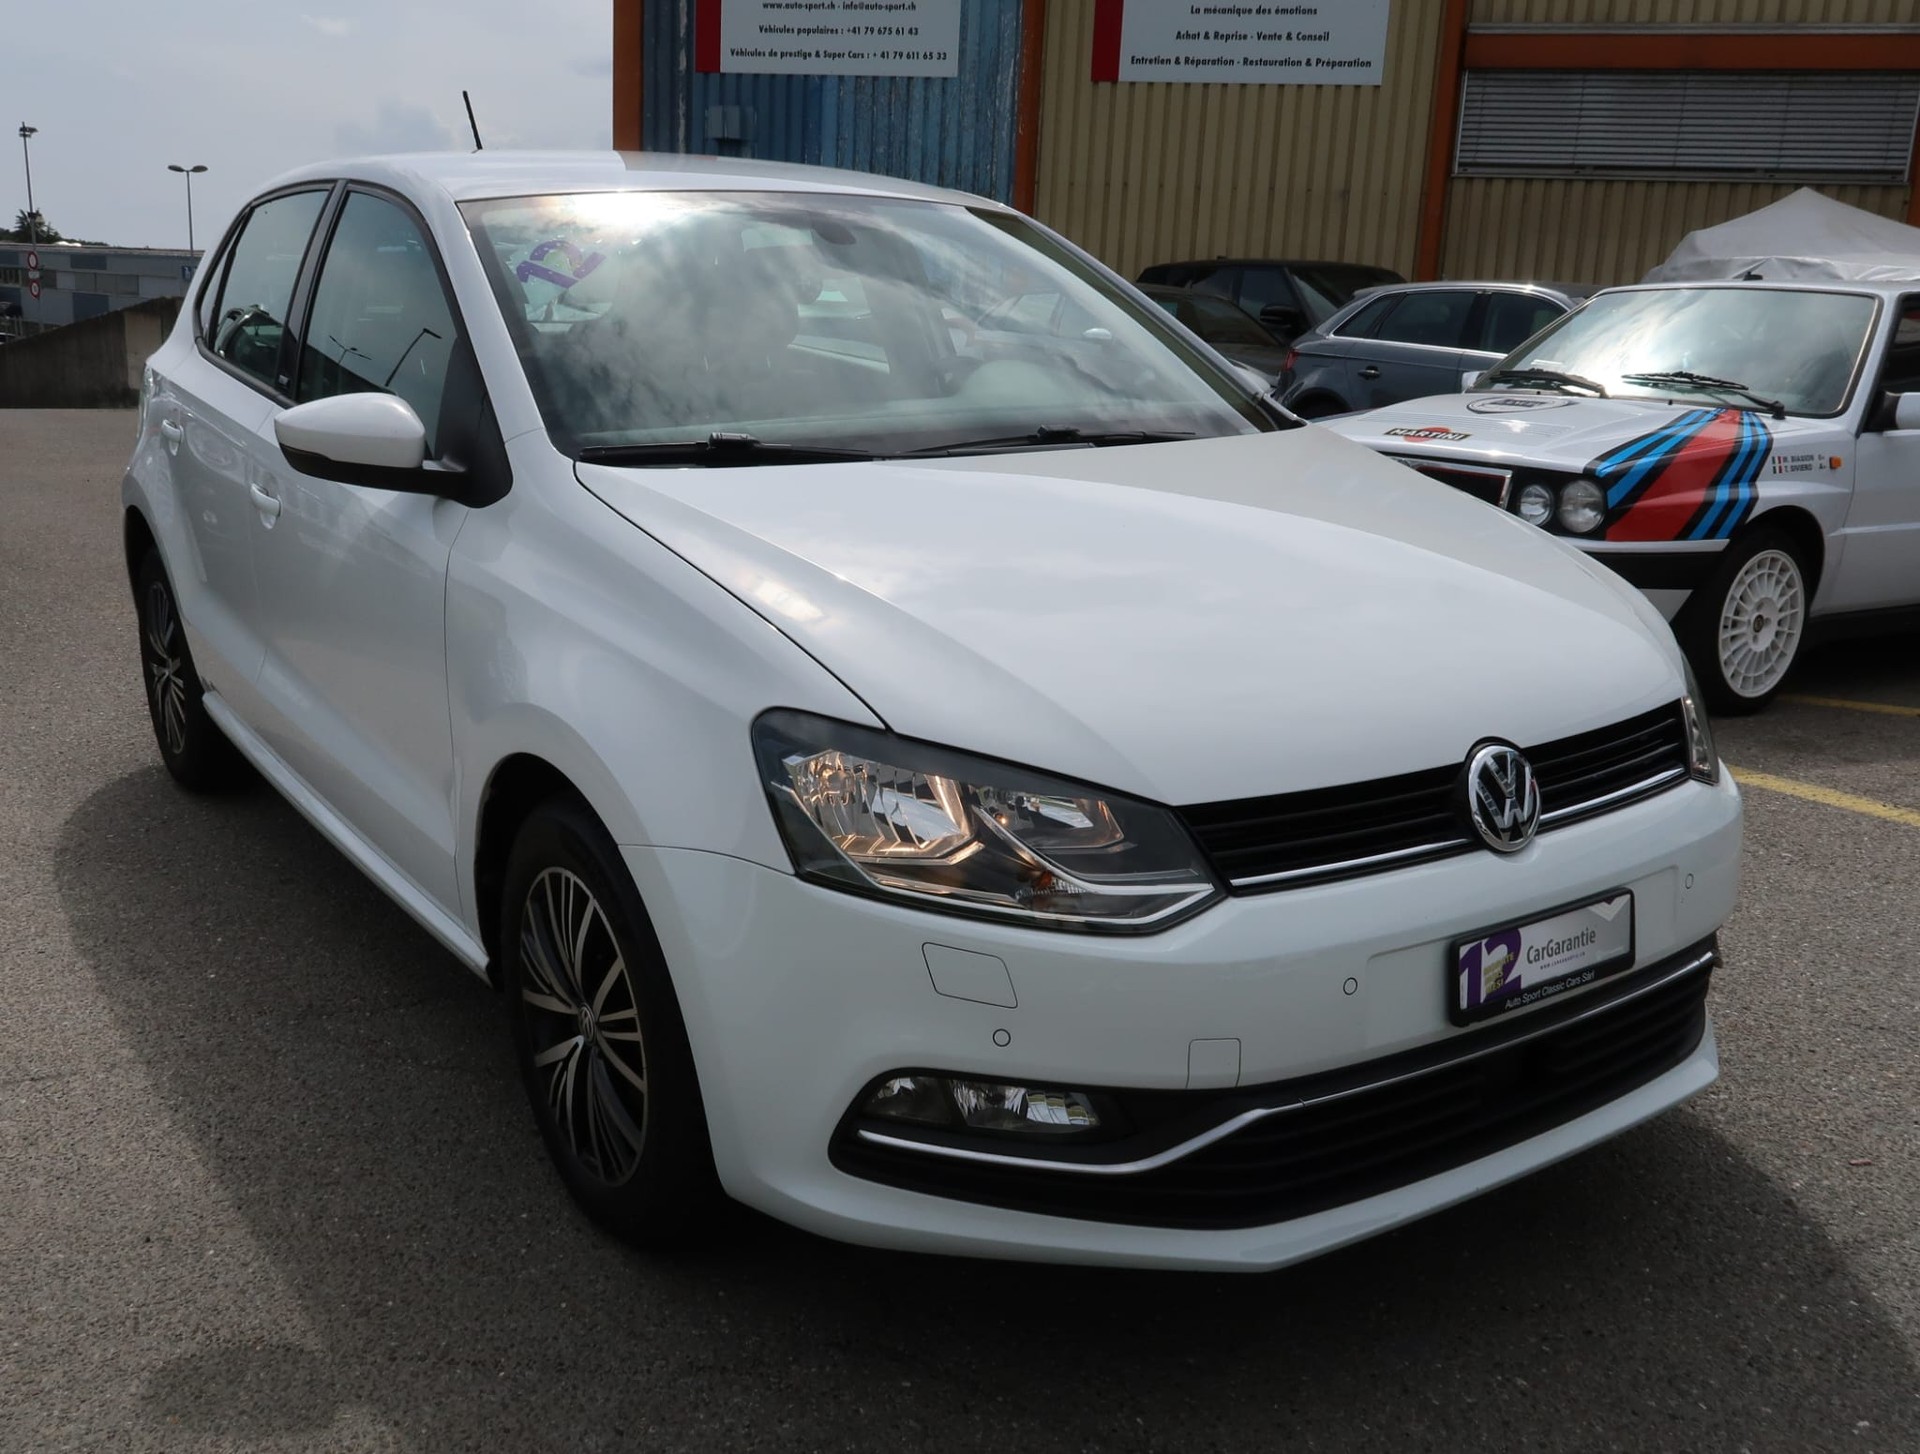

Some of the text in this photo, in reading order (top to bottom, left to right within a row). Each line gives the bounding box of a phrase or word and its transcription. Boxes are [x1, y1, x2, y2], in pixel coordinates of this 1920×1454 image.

[762, 1, 835, 12] www.auto-sport.ch
[842, 2, 916, 13] info@auto-sport.ch
[1190, 4, 1318, 17] La mécanique des émotions
[758, 24, 795, 35] Véhicules
[796, 25, 839, 37] populaires
[846, 26, 861, 35] +41
[863, 26, 875, 36] 79
[877, 26, 893, 36] 675
[895, 27, 905, 37] 61
[907, 27, 919, 36] 43
[1175, 30, 1201, 41] Achat
[1203, 31, 1211, 41] &
[1213, 31, 1248, 43] Reprise
[1256, 31, 1283, 41] Vente
[1285, 31, 1293, 41] &
[1296, 31, 1330, 42] Conseil
[730, 48, 766, 58] Véhicules
[768, 48, 778, 58] de
[780, 49, 812, 60] prestige
[814, 50, 821, 59] &
[823, 50, 845, 61] Super
[847, 50, 865, 60] Cars
[880, 51, 890, 60] 41
[892, 51, 903, 61] 79
[905, 51, 920, 61] 611
[922, 51, 934, 61] 65
[936, 52, 948, 61] 33
[1131, 55, 1172, 66] Entretien
[1174, 56, 1181, 66] &
[1184, 56, 1235, 68] Réparation
[1242, 57, 1303, 67] Restauration
[1304, 58, 1313, 68] &
[1315, 58, 1372, 70] Préparation
[1389, 428, 1465, 440] MARTINI
[1526, 926, 1597, 965] CarGarantie
[1459, 928, 1522, 1010] 12
[1504, 996, 1522, 1010] Auto
[1522, 988, 1541, 1004] Sport
[1542, 981, 1566, 997] Classic
[1566, 975, 1582, 988] Cars
